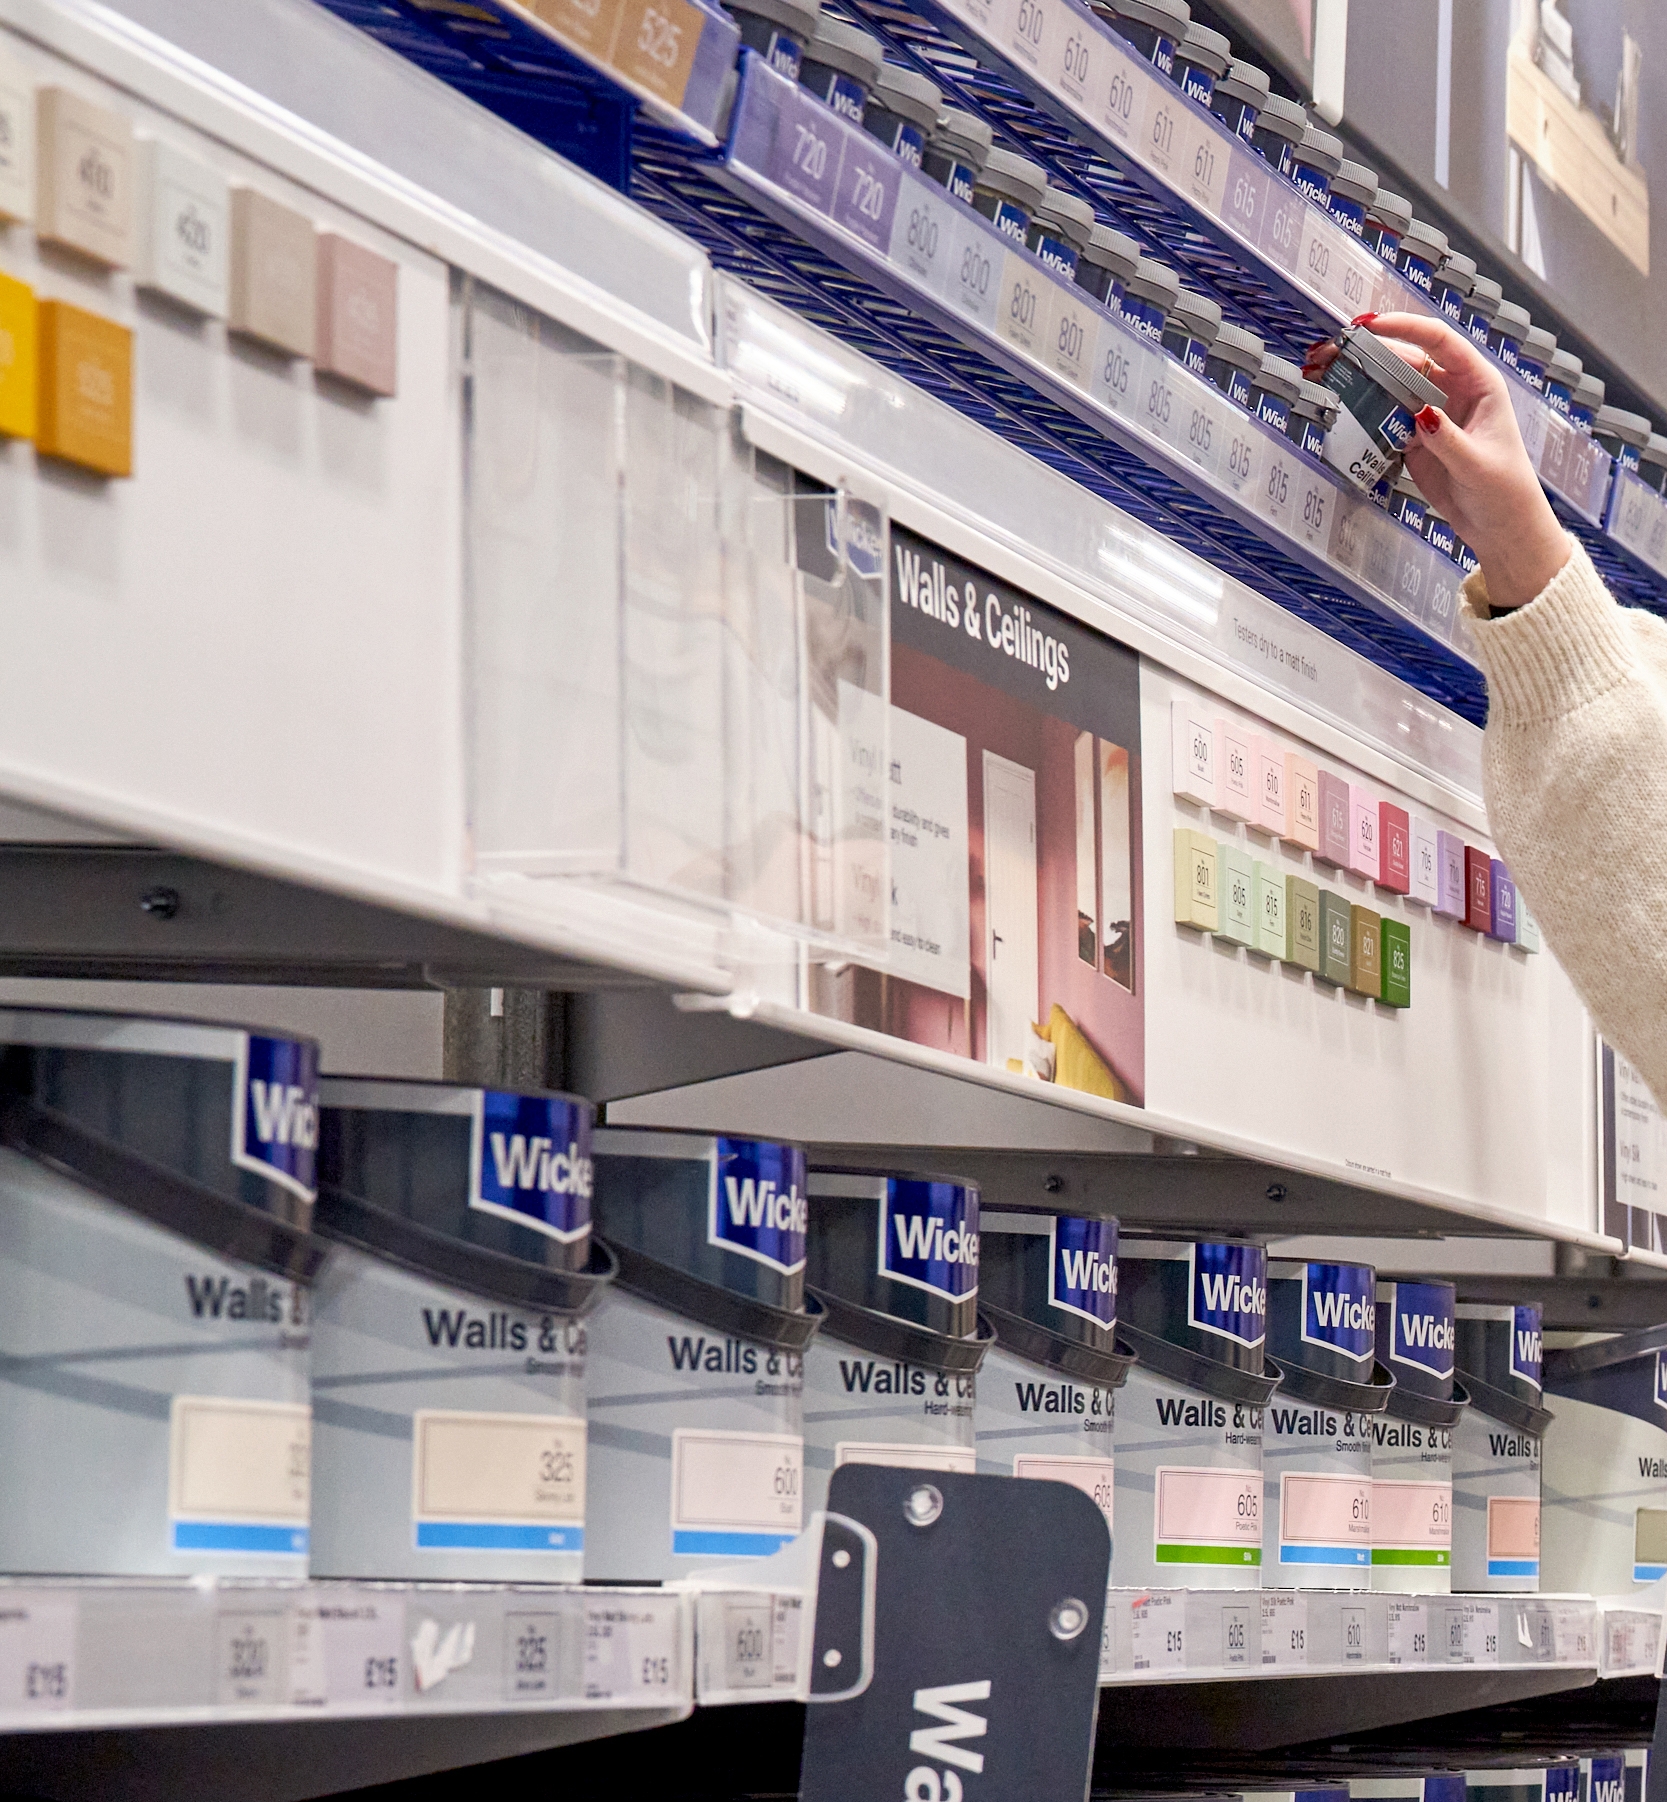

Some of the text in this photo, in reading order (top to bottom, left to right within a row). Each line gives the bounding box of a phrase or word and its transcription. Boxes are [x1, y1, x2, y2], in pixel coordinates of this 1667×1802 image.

[637, 6, 683, 68] 525
[1018, 3, 1043, 38] 610
[1064, 45, 1089, 83] 610
[1109, 81, 1133, 119] 610
[1153, 111, 1173, 151] 611
[790, 122, 827, 180] 720
[1194, 146, 1215, 186] 611
[850, 165, 884, 221] 720
[1233, 177, 1257, 219] 615
[907, 207, 939, 260] 800
[1272, 208, 1293, 249] 615
[960, 244, 990, 296] 800
[1308, 237, 1330, 278] 620
[1343, 268, 1364, 305] 620
[1010, 282, 1037, 329] 801
[1058, 315, 1084, 361] 801
[1104, 348, 1129, 393] 805
[1149, 379, 1172, 423] 805
[1189, 408, 1213, 451] 805
[1229, 438, 1251, 478] 815
[1361, 448, 1387, 475] Walls
[1268, 464, 1289, 505] 815
[1304, 489, 1325, 529] 815
[1402, 561, 1421, 597] 820
[895, 544, 1070, 691] Walls & Ceilings
[1431, 582, 1451, 618] 820
[1233, 617, 1258, 649] Testers
[1259, 633, 1270, 659] dry
[1270, 640, 1278, 660] to
[1285, 651, 1300, 673] matt
[1301, 656, 1318, 683] finish
[1193, 738, 1208, 762] 600
[1230, 753, 1244, 777] 605
[1266, 772, 1279, 794] 610
[1300, 789, 1311, 811] 611
[1361, 822, 1373, 842] 620
[1392, 839, 1404, 859] 621
[1196, 864, 1210, 887] 801
[1421, 851, 1432, 871] 705
[1233, 884, 1246, 907] 805
[1265, 894, 1278, 917] 815
[1475, 879, 1486, 897] 715
[1300, 909, 1312, 931] 816
[1332, 924, 1345, 946] 820
[1392, 949, 1405, 970] 825
[187, 1275, 283, 1324] Walls
[423, 1308, 558, 1353] Walls &
[668, 1335, 782, 1377] Walls &
[839, 1359, 927, 1398] Walls
[934, 1363, 951, 1398] &
[1016, 1381, 1105, 1417] Walls &
[1156, 1398, 1227, 1428] Walls
[1232, 1402, 1246, 1429] &
[1271, 1408, 1338, 1436] Walls
[1343, 1411, 1356, 1438] &
[1427, 1426, 1439, 1449] &
[1489, 1432, 1532, 1459] Walls
[773, 1466, 800, 1499] 600
[1237, 1493, 1258, 1517] 605
[1352, 1498, 1370, 1520] 610
[1432, 1502, 1449, 1523] 610
[1167, 1630, 1182, 1652] £15
[1228, 1624, 1244, 1648] 605
[1291, 1629, 1305, 1650] £15
[1347, 1624, 1361, 1646] 610
[1414, 1633, 1426, 1653] £15
[1486, 1633, 1497, 1653] £15
